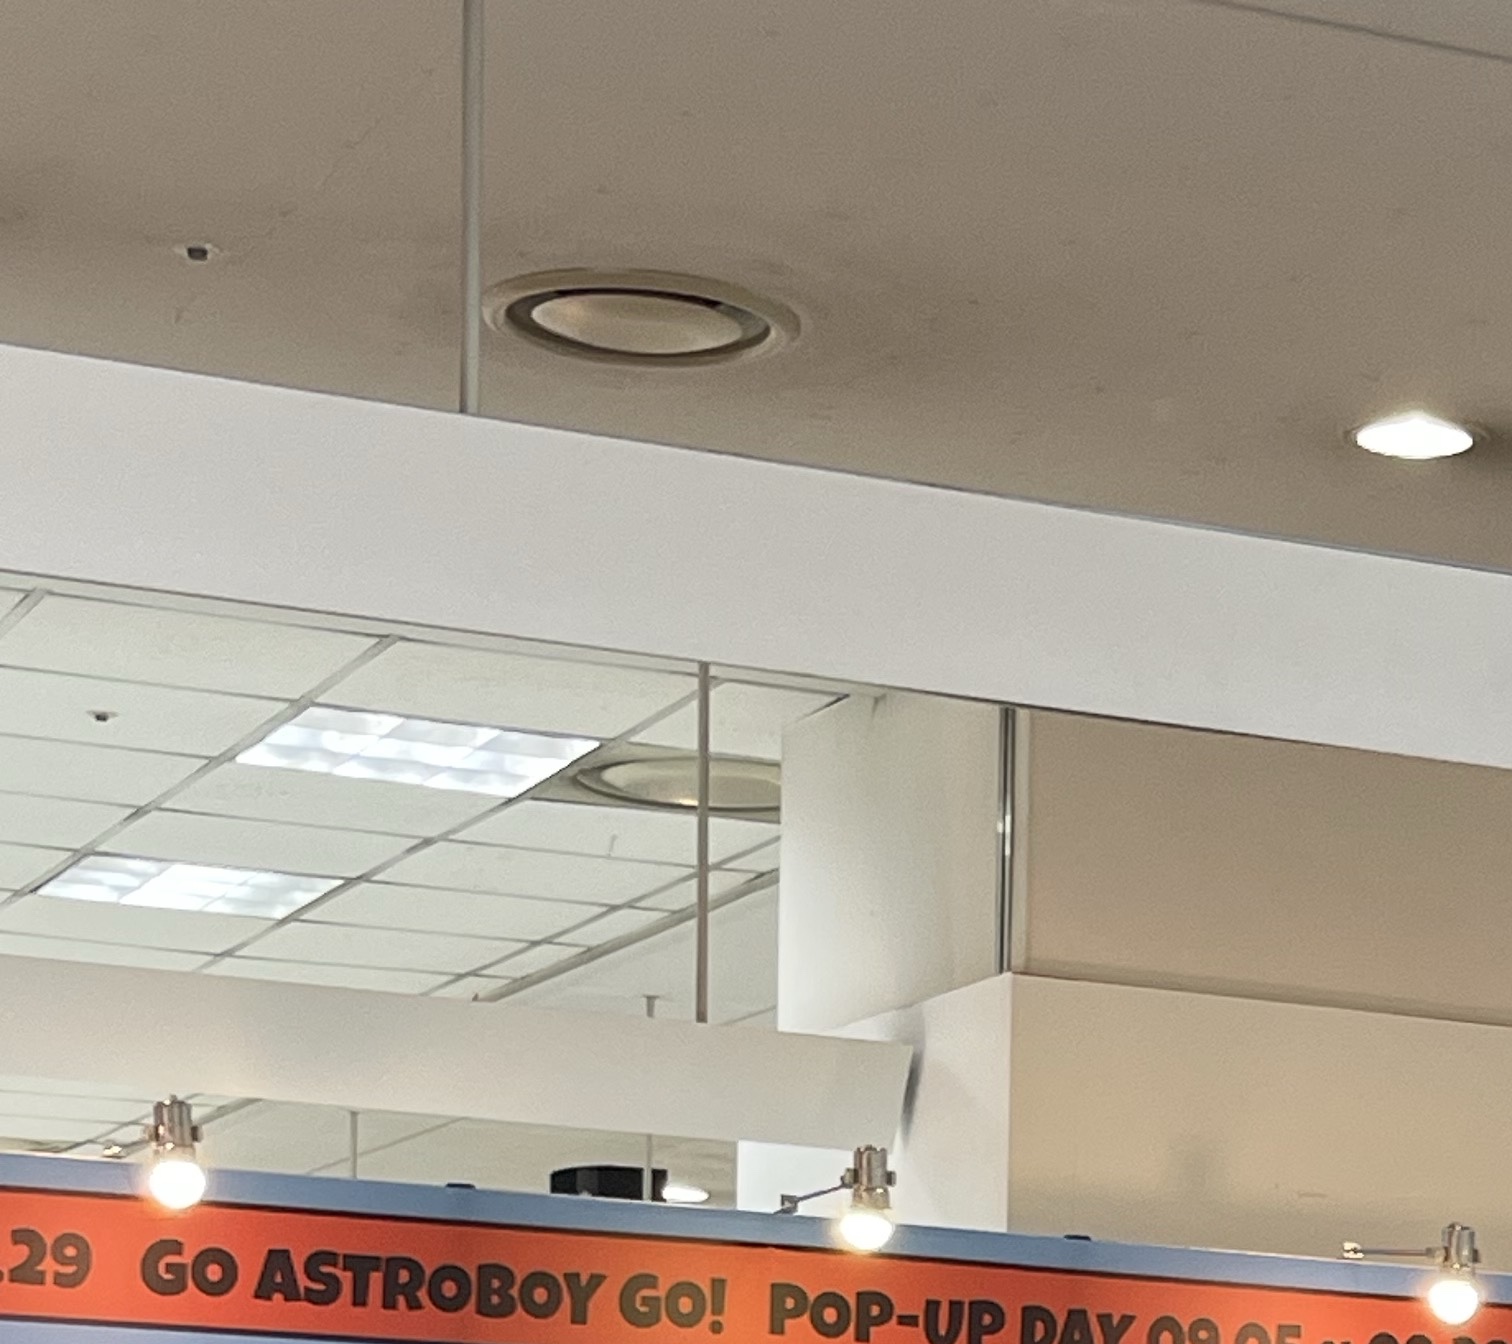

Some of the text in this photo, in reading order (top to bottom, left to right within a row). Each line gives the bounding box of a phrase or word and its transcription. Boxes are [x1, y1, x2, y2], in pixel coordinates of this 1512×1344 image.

[140, 1239, 239, 1297] GO
[254, 1249, 606, 1325] ASTROBOY
[619, 1273, 727, 1334] GO!
